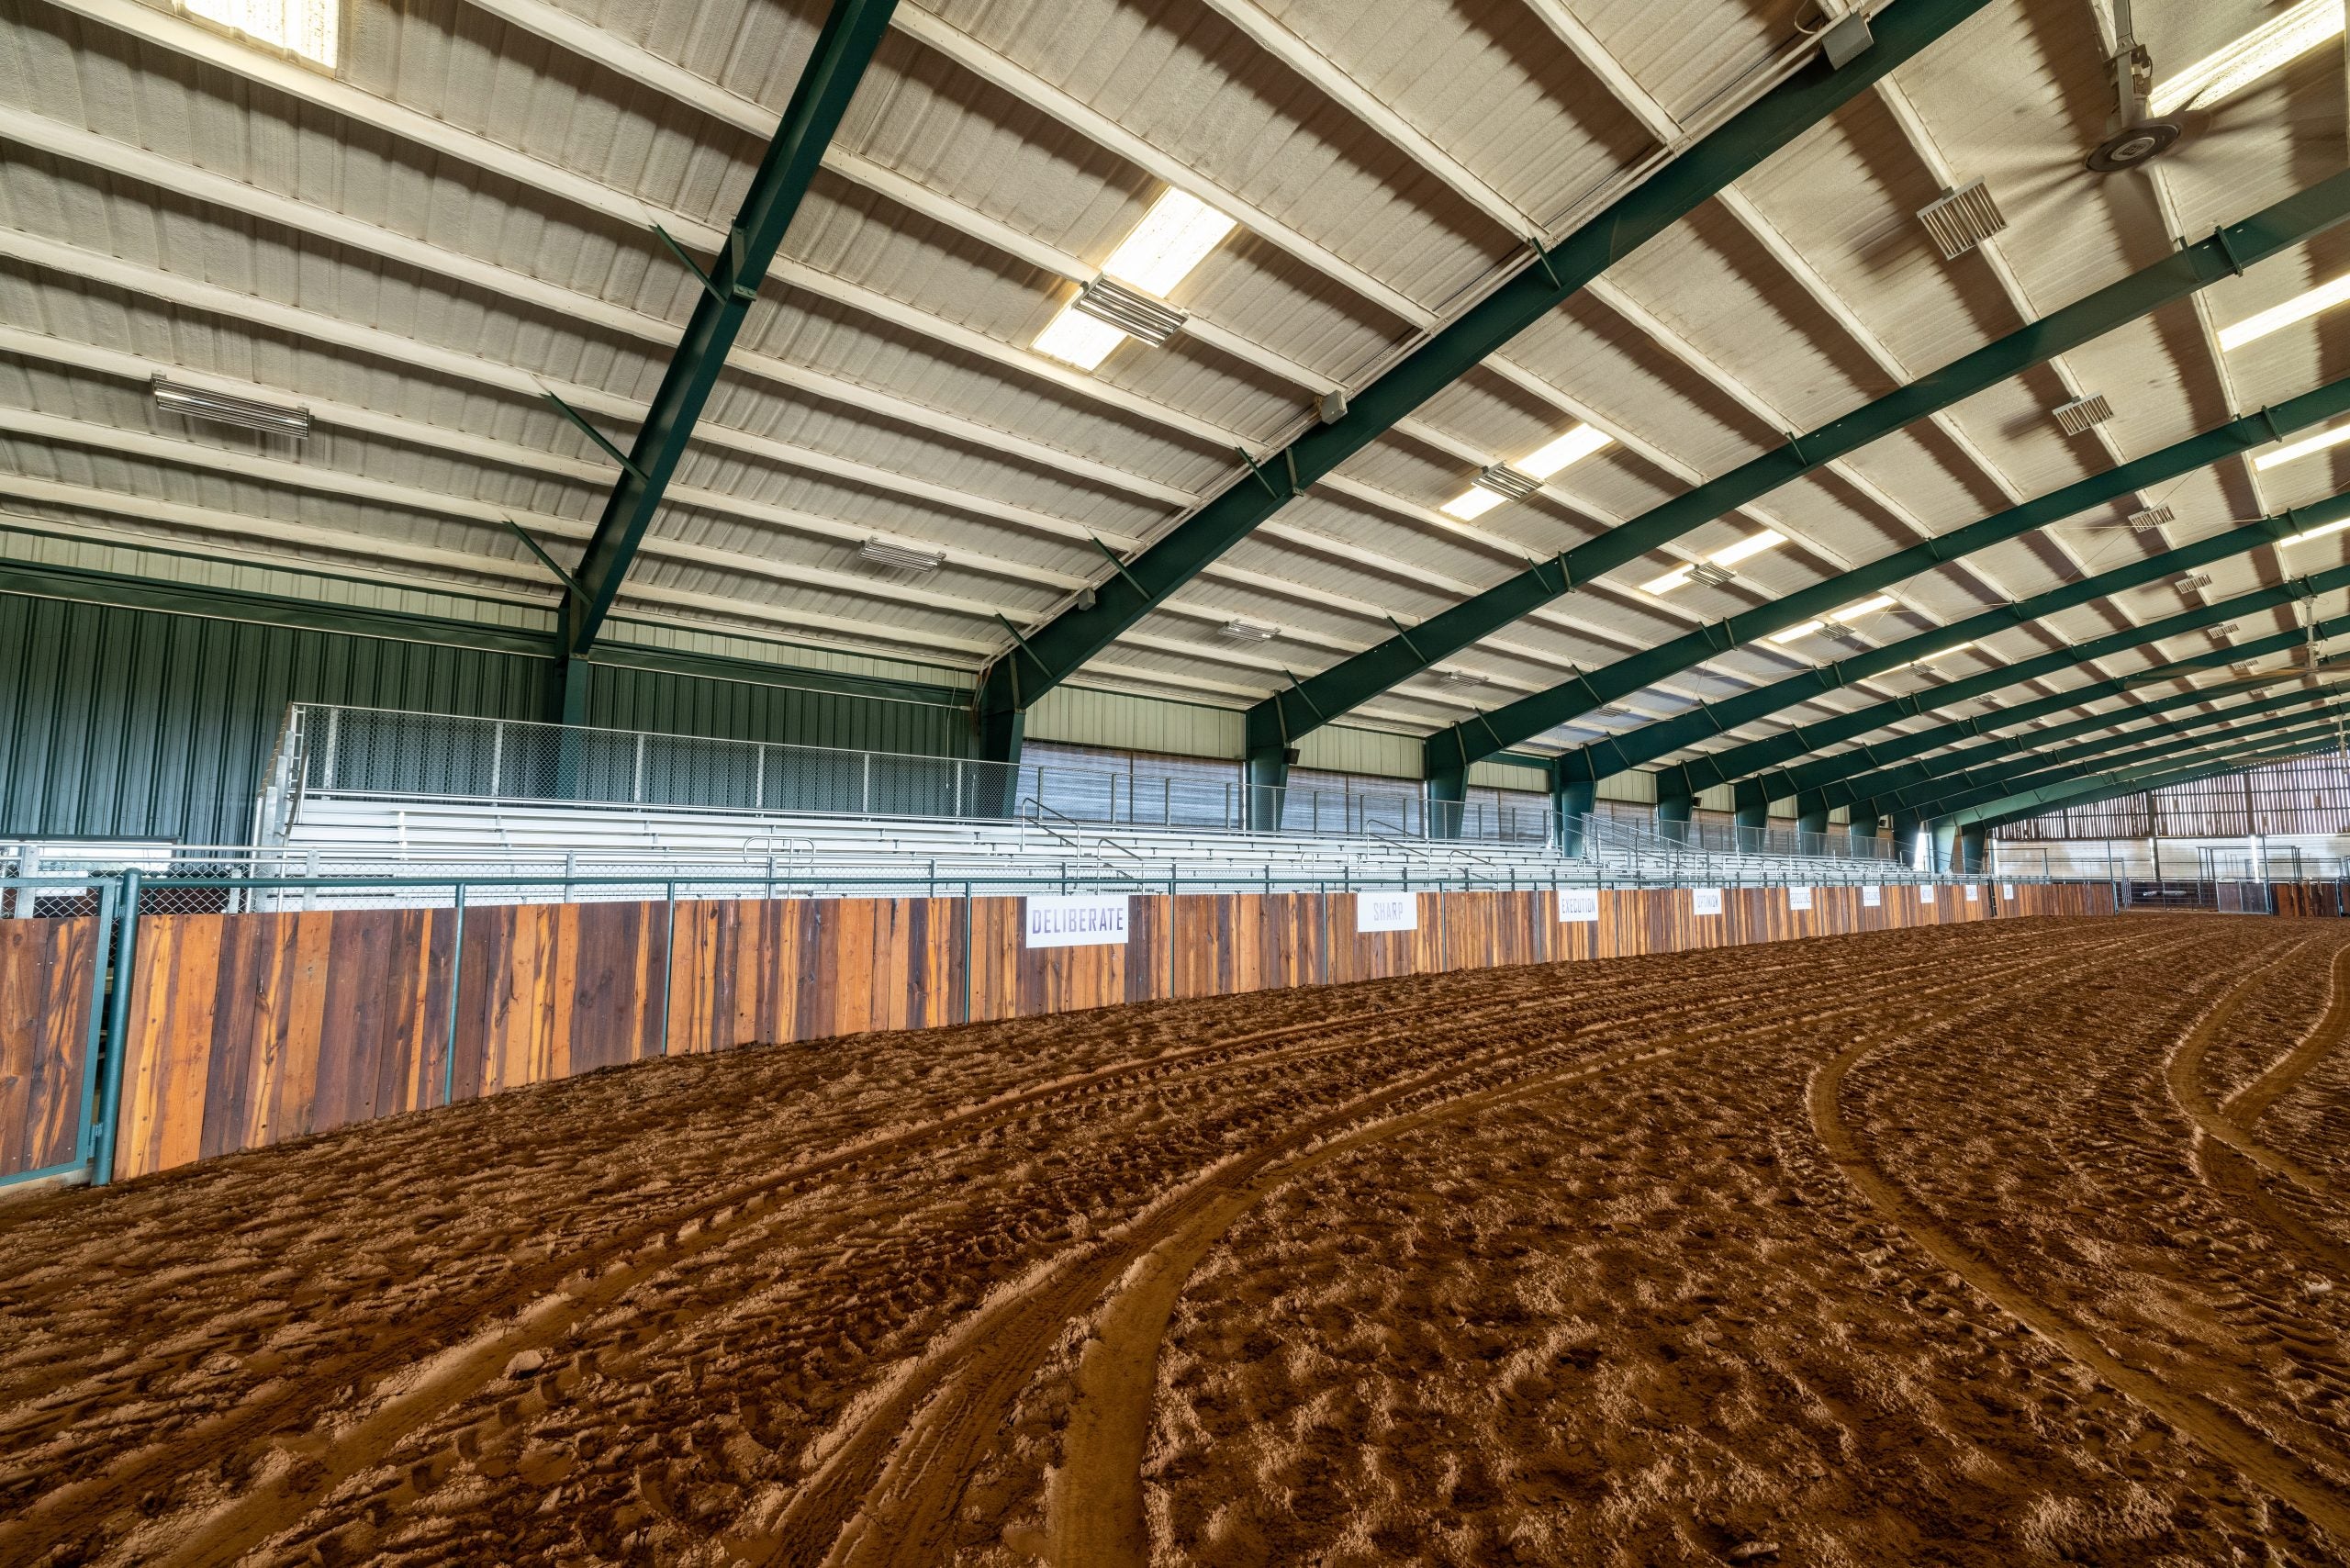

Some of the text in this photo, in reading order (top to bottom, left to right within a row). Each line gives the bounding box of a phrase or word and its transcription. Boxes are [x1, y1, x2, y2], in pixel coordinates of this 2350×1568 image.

[1561, 898, 1595, 913] EXECUTION
[1697, 895, 1718, 908] OPTIMISM
[1373, 902, 1404, 922] SHARP
[1032, 907, 1124, 935] DELIBERATE
